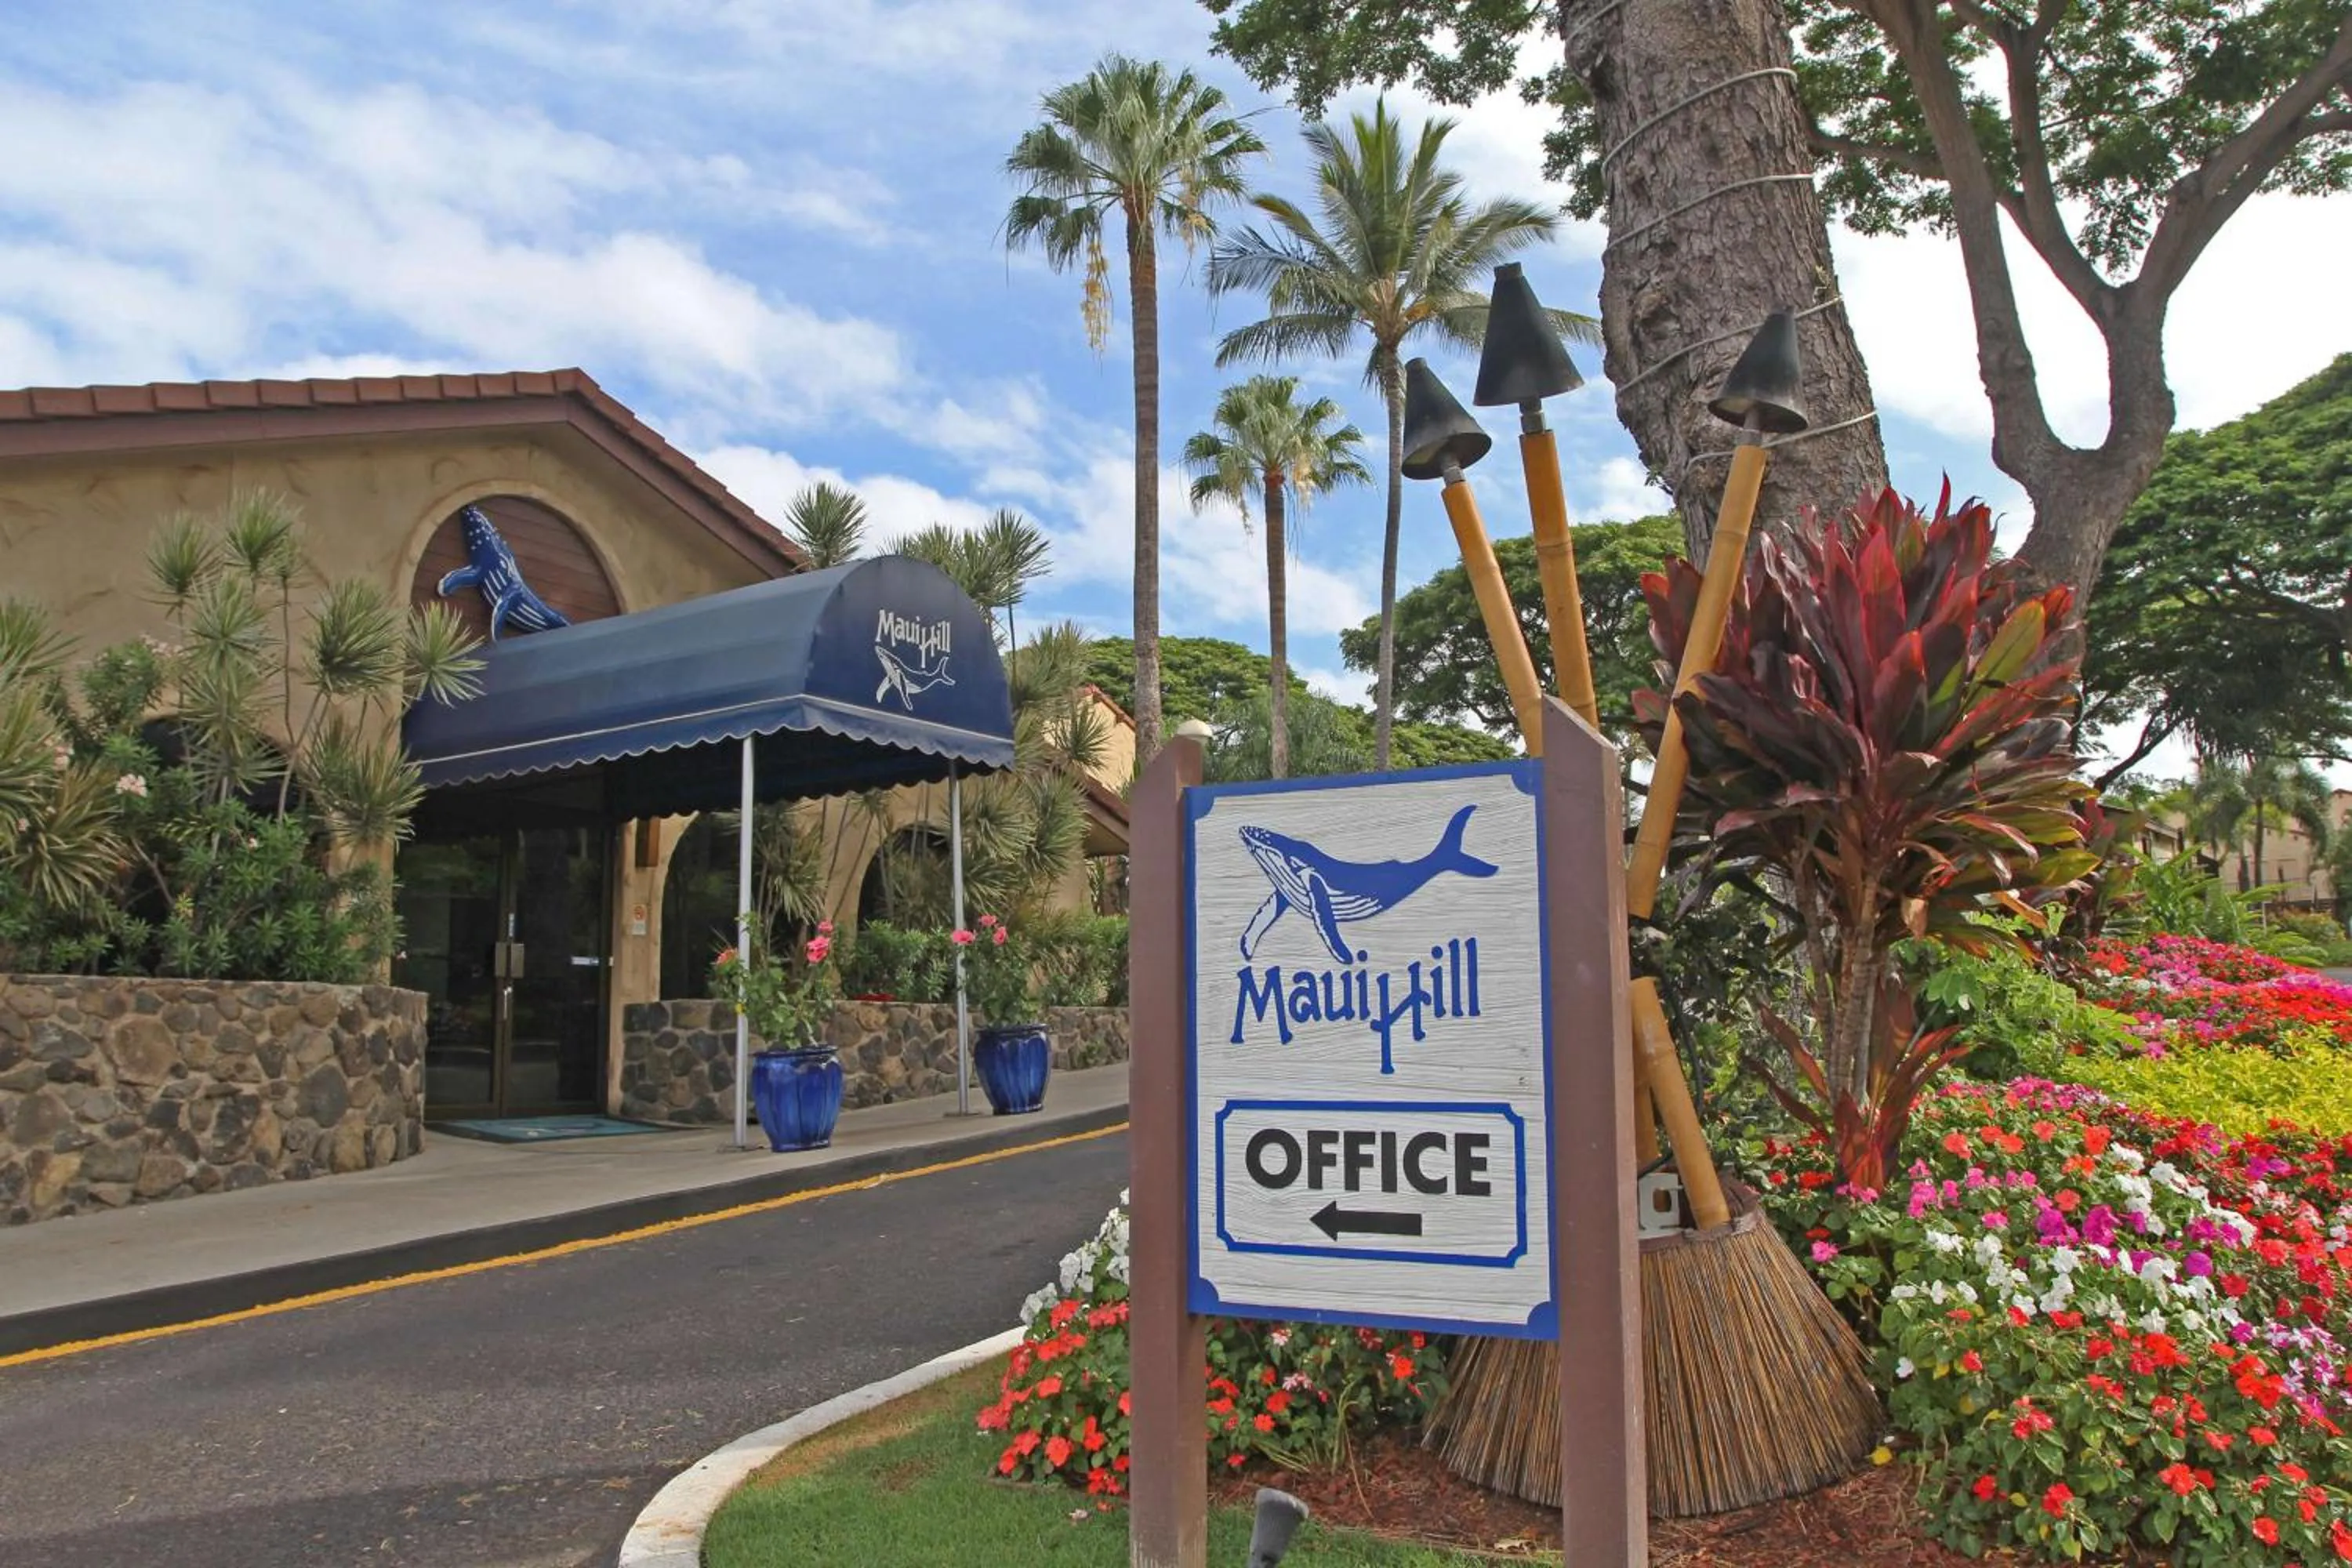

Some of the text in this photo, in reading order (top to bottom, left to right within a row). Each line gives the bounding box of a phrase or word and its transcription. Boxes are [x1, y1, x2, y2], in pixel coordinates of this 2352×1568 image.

[875, 609, 951, 668] Maui Hill
[1230, 937, 1480, 1074] Maui Hill
[1246, 1128, 1491, 1196] OFFICE
